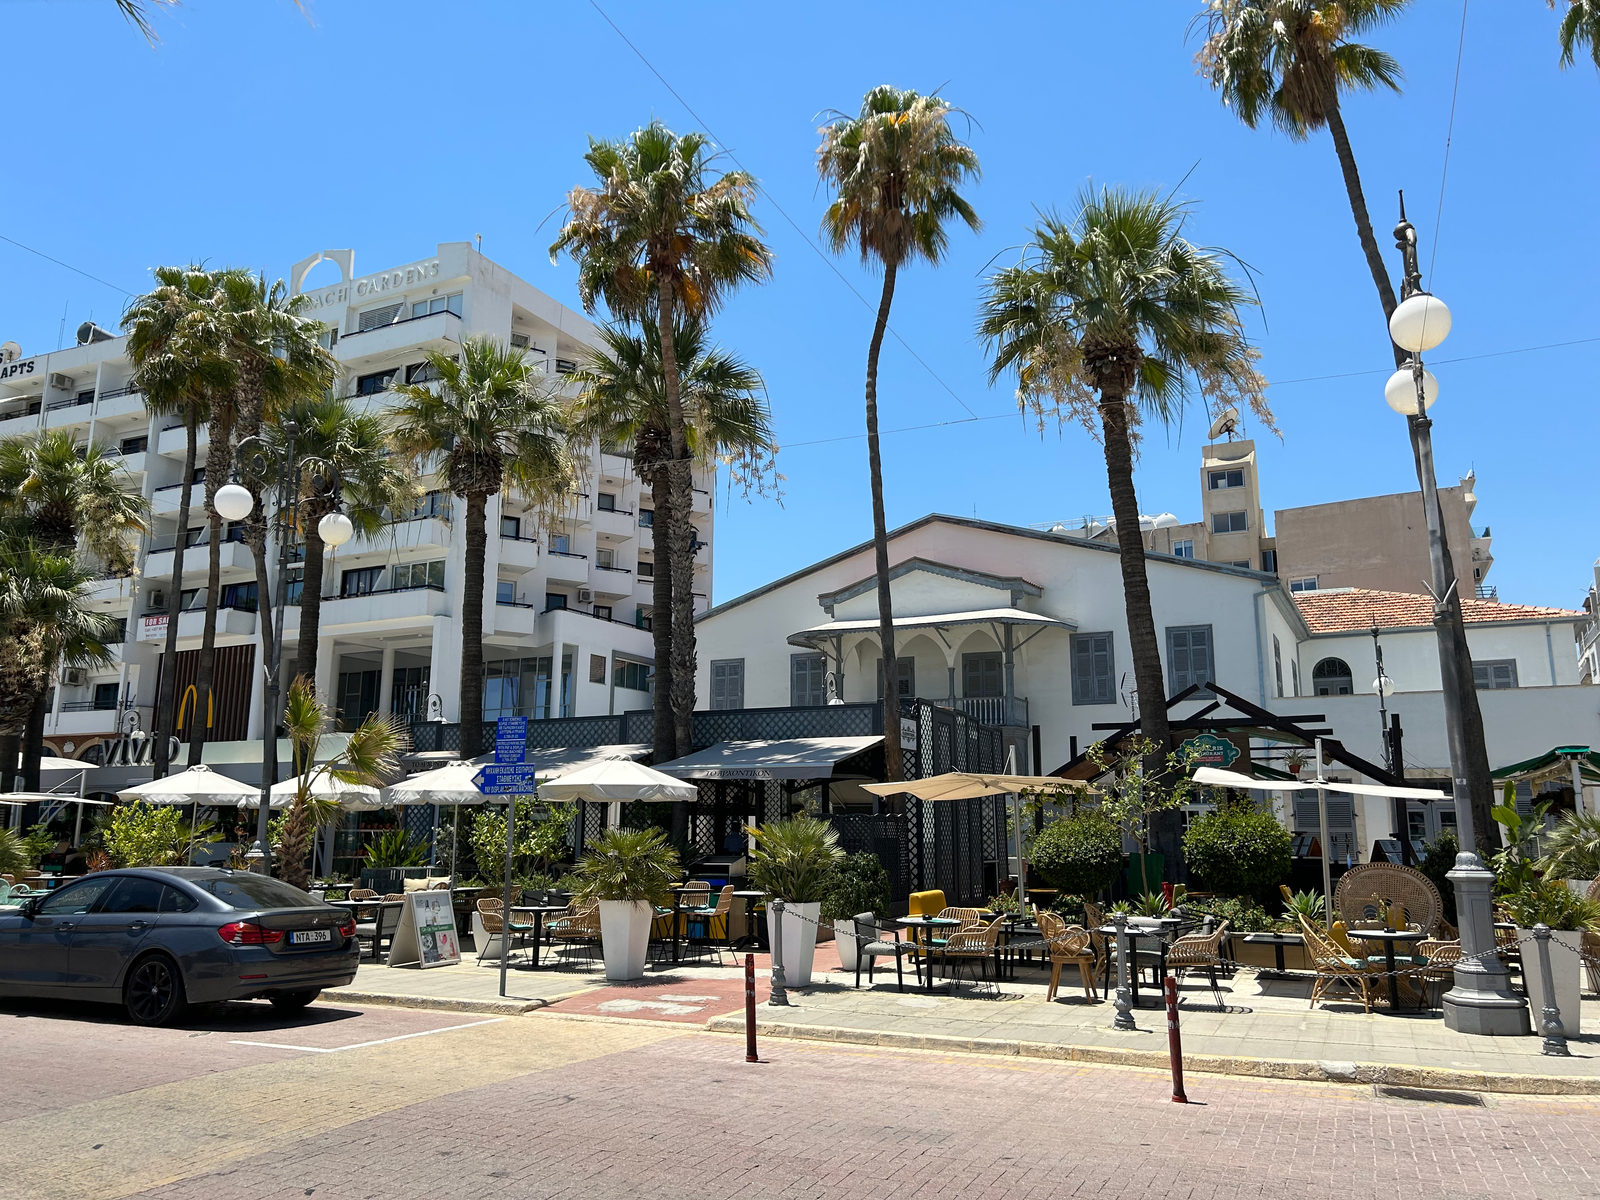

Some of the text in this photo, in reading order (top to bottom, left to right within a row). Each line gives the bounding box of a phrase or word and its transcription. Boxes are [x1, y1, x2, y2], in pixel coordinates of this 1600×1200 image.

[296, 260, 440, 314] EACH GARDENS
[0, 360, 35, 379] APTS
[146, 618, 158, 626] FOR
[296, 931, 327, 942] NTA 396
